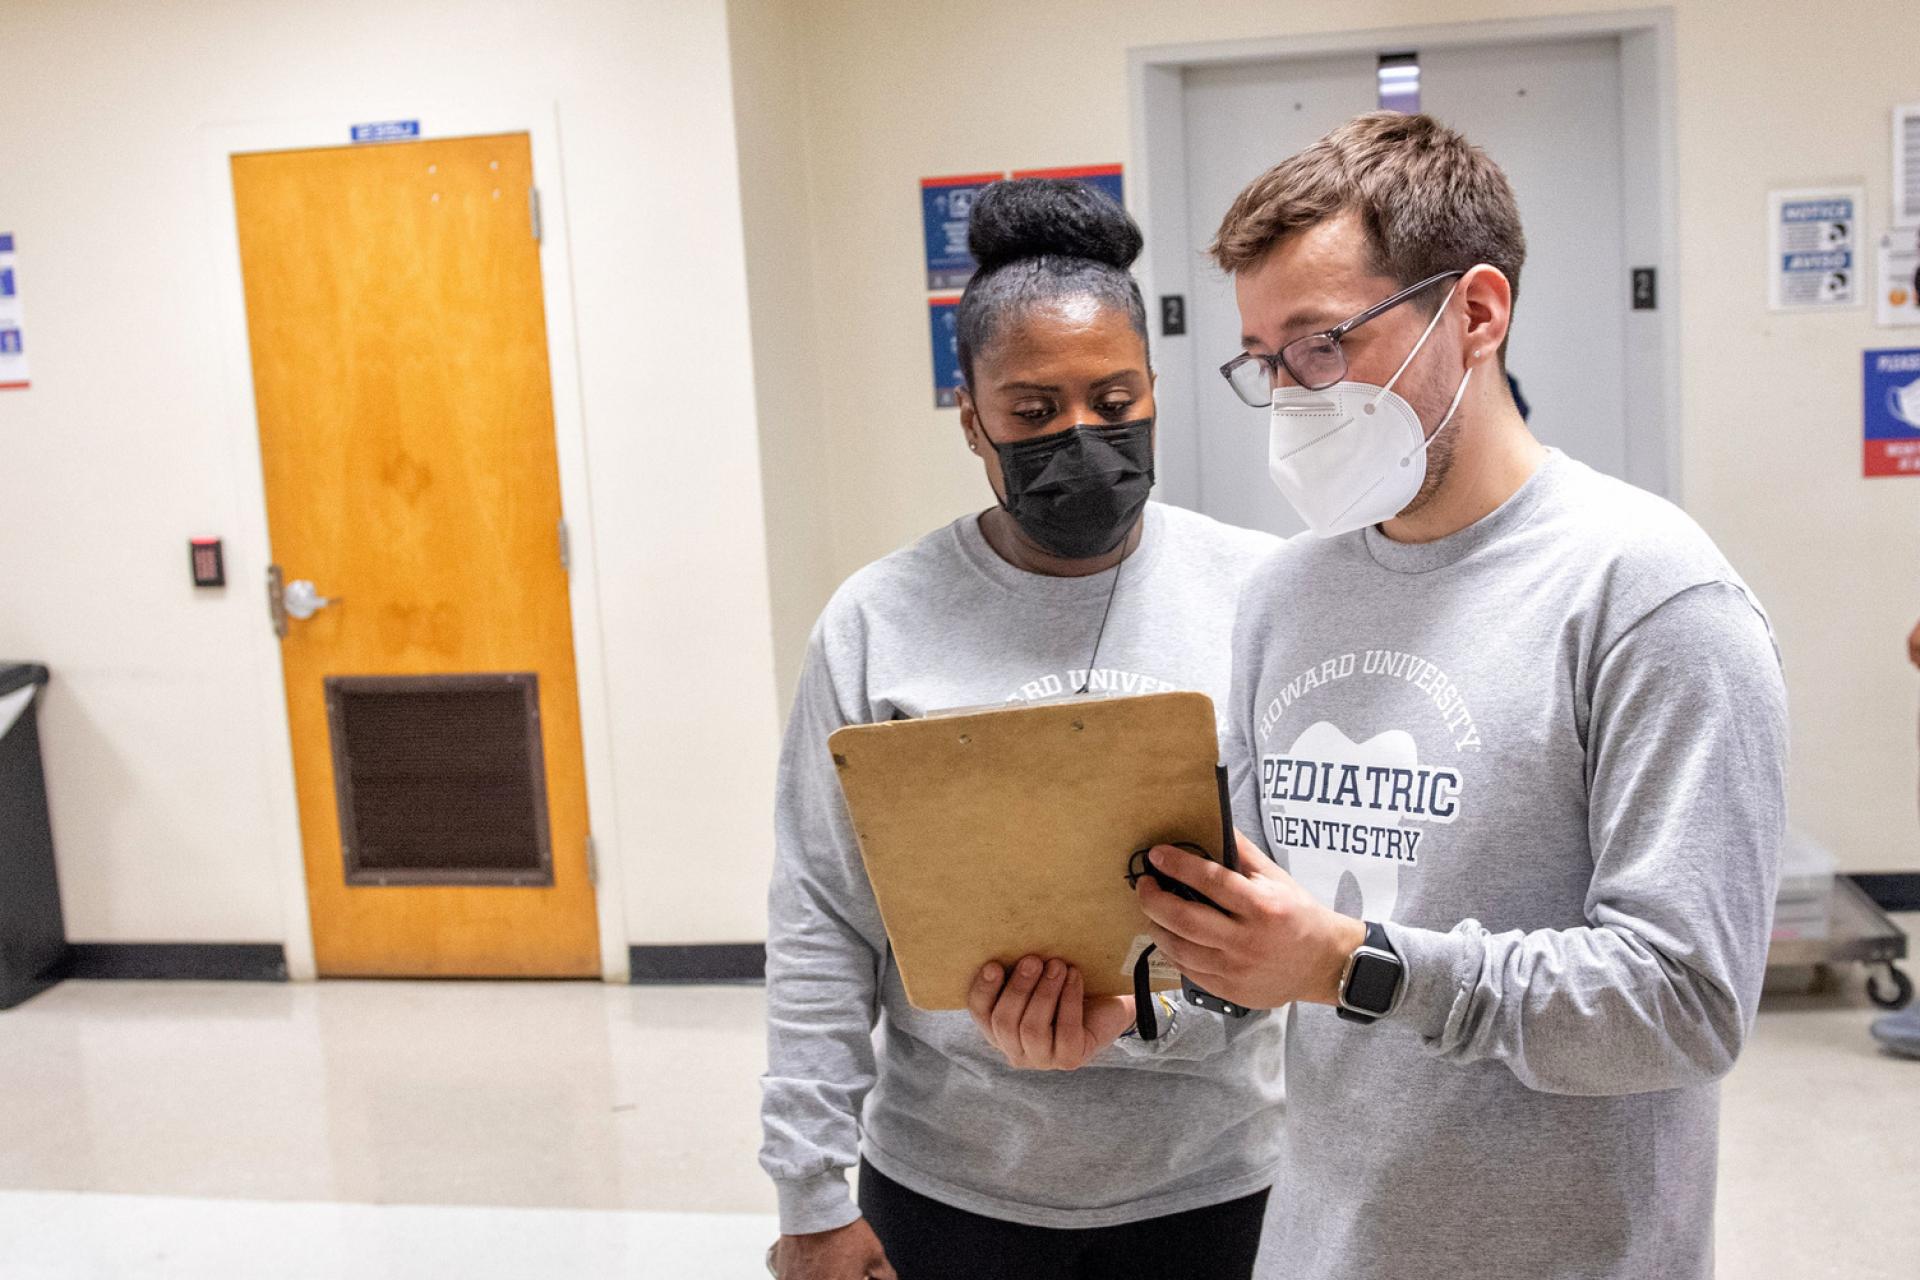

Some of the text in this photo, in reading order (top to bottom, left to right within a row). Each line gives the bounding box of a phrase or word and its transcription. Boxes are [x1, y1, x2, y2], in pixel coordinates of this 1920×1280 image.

[1785, 205, 1848, 219] NOTICE
[1636, 272, 1650, 299] 2
[1167, 299, 1180, 324] 2
[1259, 649, 1482, 753] HOWARD UNIVERSITY
[1262, 758, 1458, 818] PEDIATRIC
[1271, 815, 1421, 863] DENTISTRY
